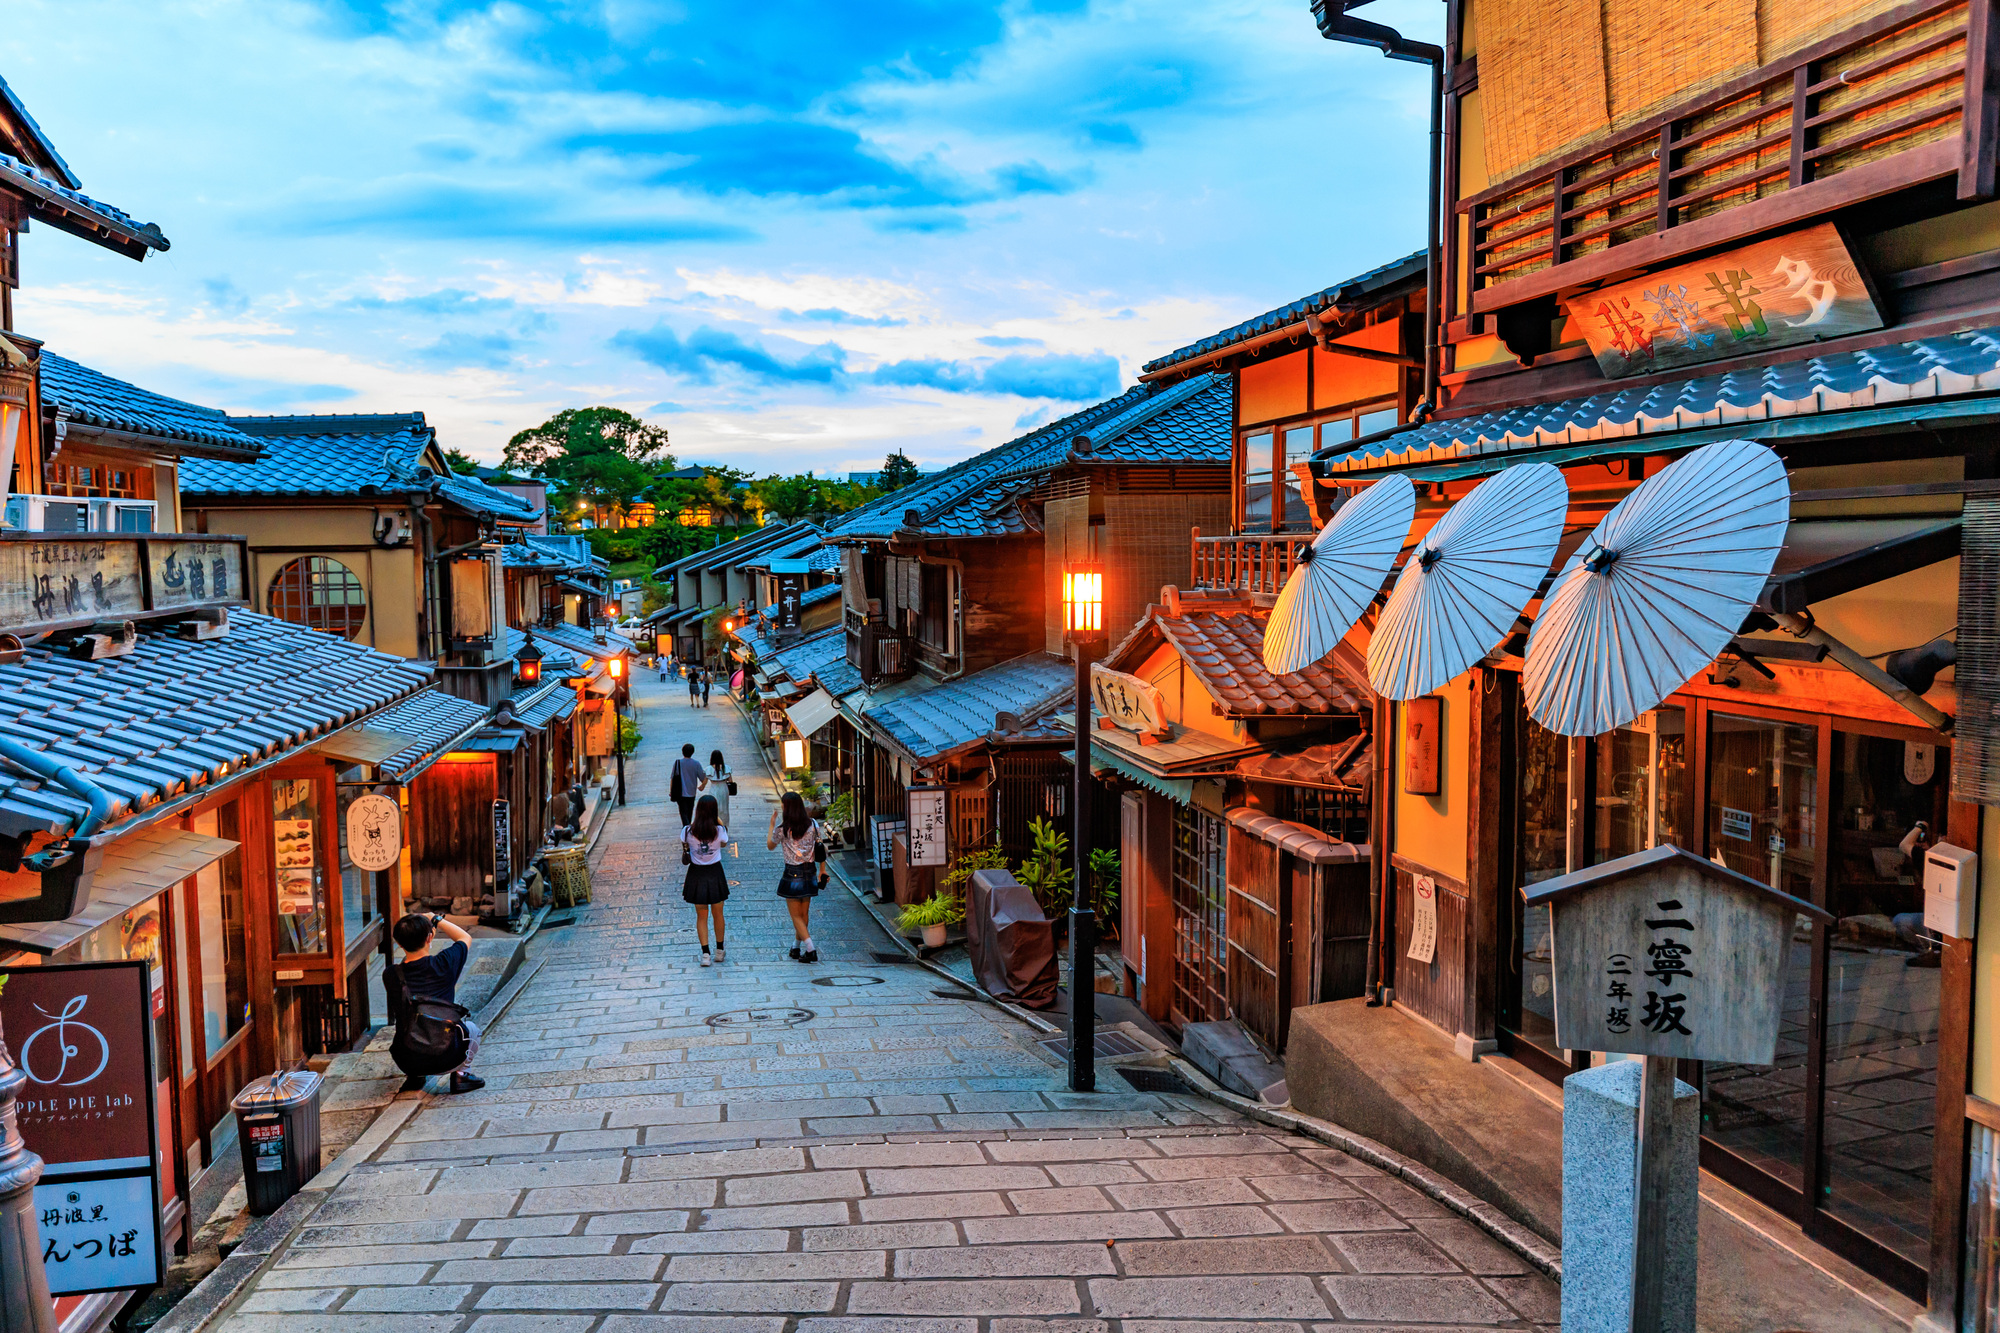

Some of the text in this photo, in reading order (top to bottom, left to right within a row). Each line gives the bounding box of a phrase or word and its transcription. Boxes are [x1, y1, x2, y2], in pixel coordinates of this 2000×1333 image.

[935, 796, 944, 825] そば処
[912, 828, 925, 859] ふたば
[1640, 899, 1695, 1036] 二寧坂
[1606, 953, 1633, 1034] （二年坂）
[15, 1093, 133, 1114] PPLE PIE lab
[41, 1204, 108, 1227] 丹波黒
[43, 1228, 138, 1264] んつば
